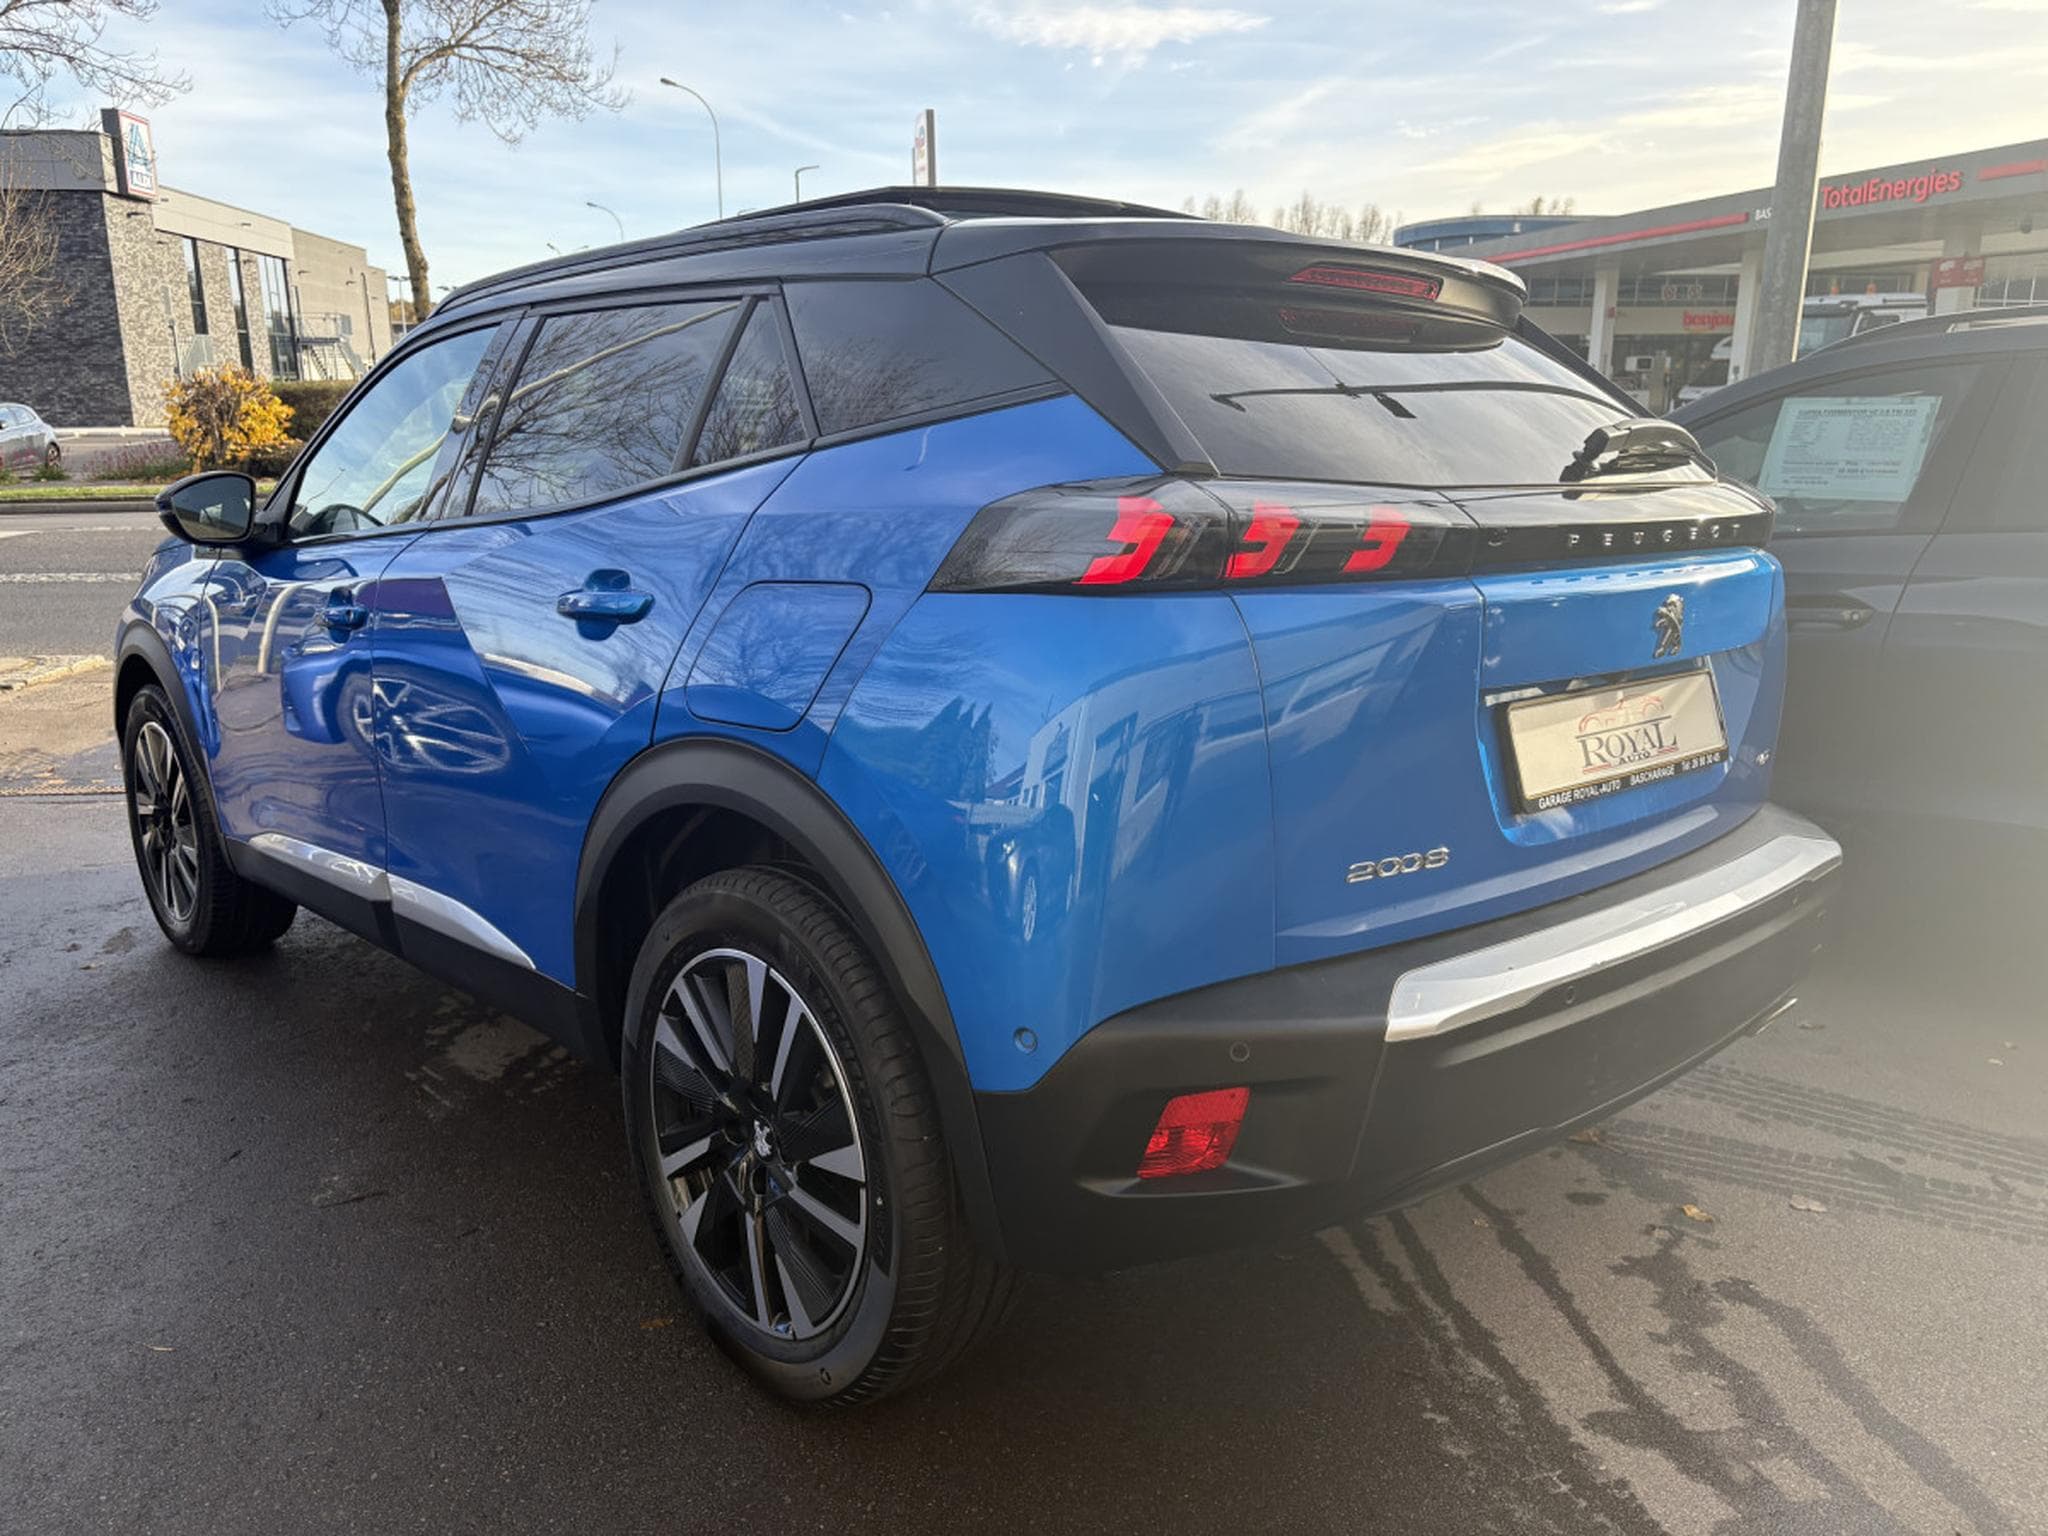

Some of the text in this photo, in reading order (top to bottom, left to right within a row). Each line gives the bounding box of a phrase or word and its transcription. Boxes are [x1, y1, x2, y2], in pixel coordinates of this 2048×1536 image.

[1820, 168, 1963, 209] TotalEnergies
[1569, 523, 1741, 547] PEUGEOT
[1577, 721, 1678, 768] ROYAL
[1618, 750, 1651, 765] AUTO
[1538, 791, 1573, 809] GARAGE
[1345, 846, 1450, 884] 2008
